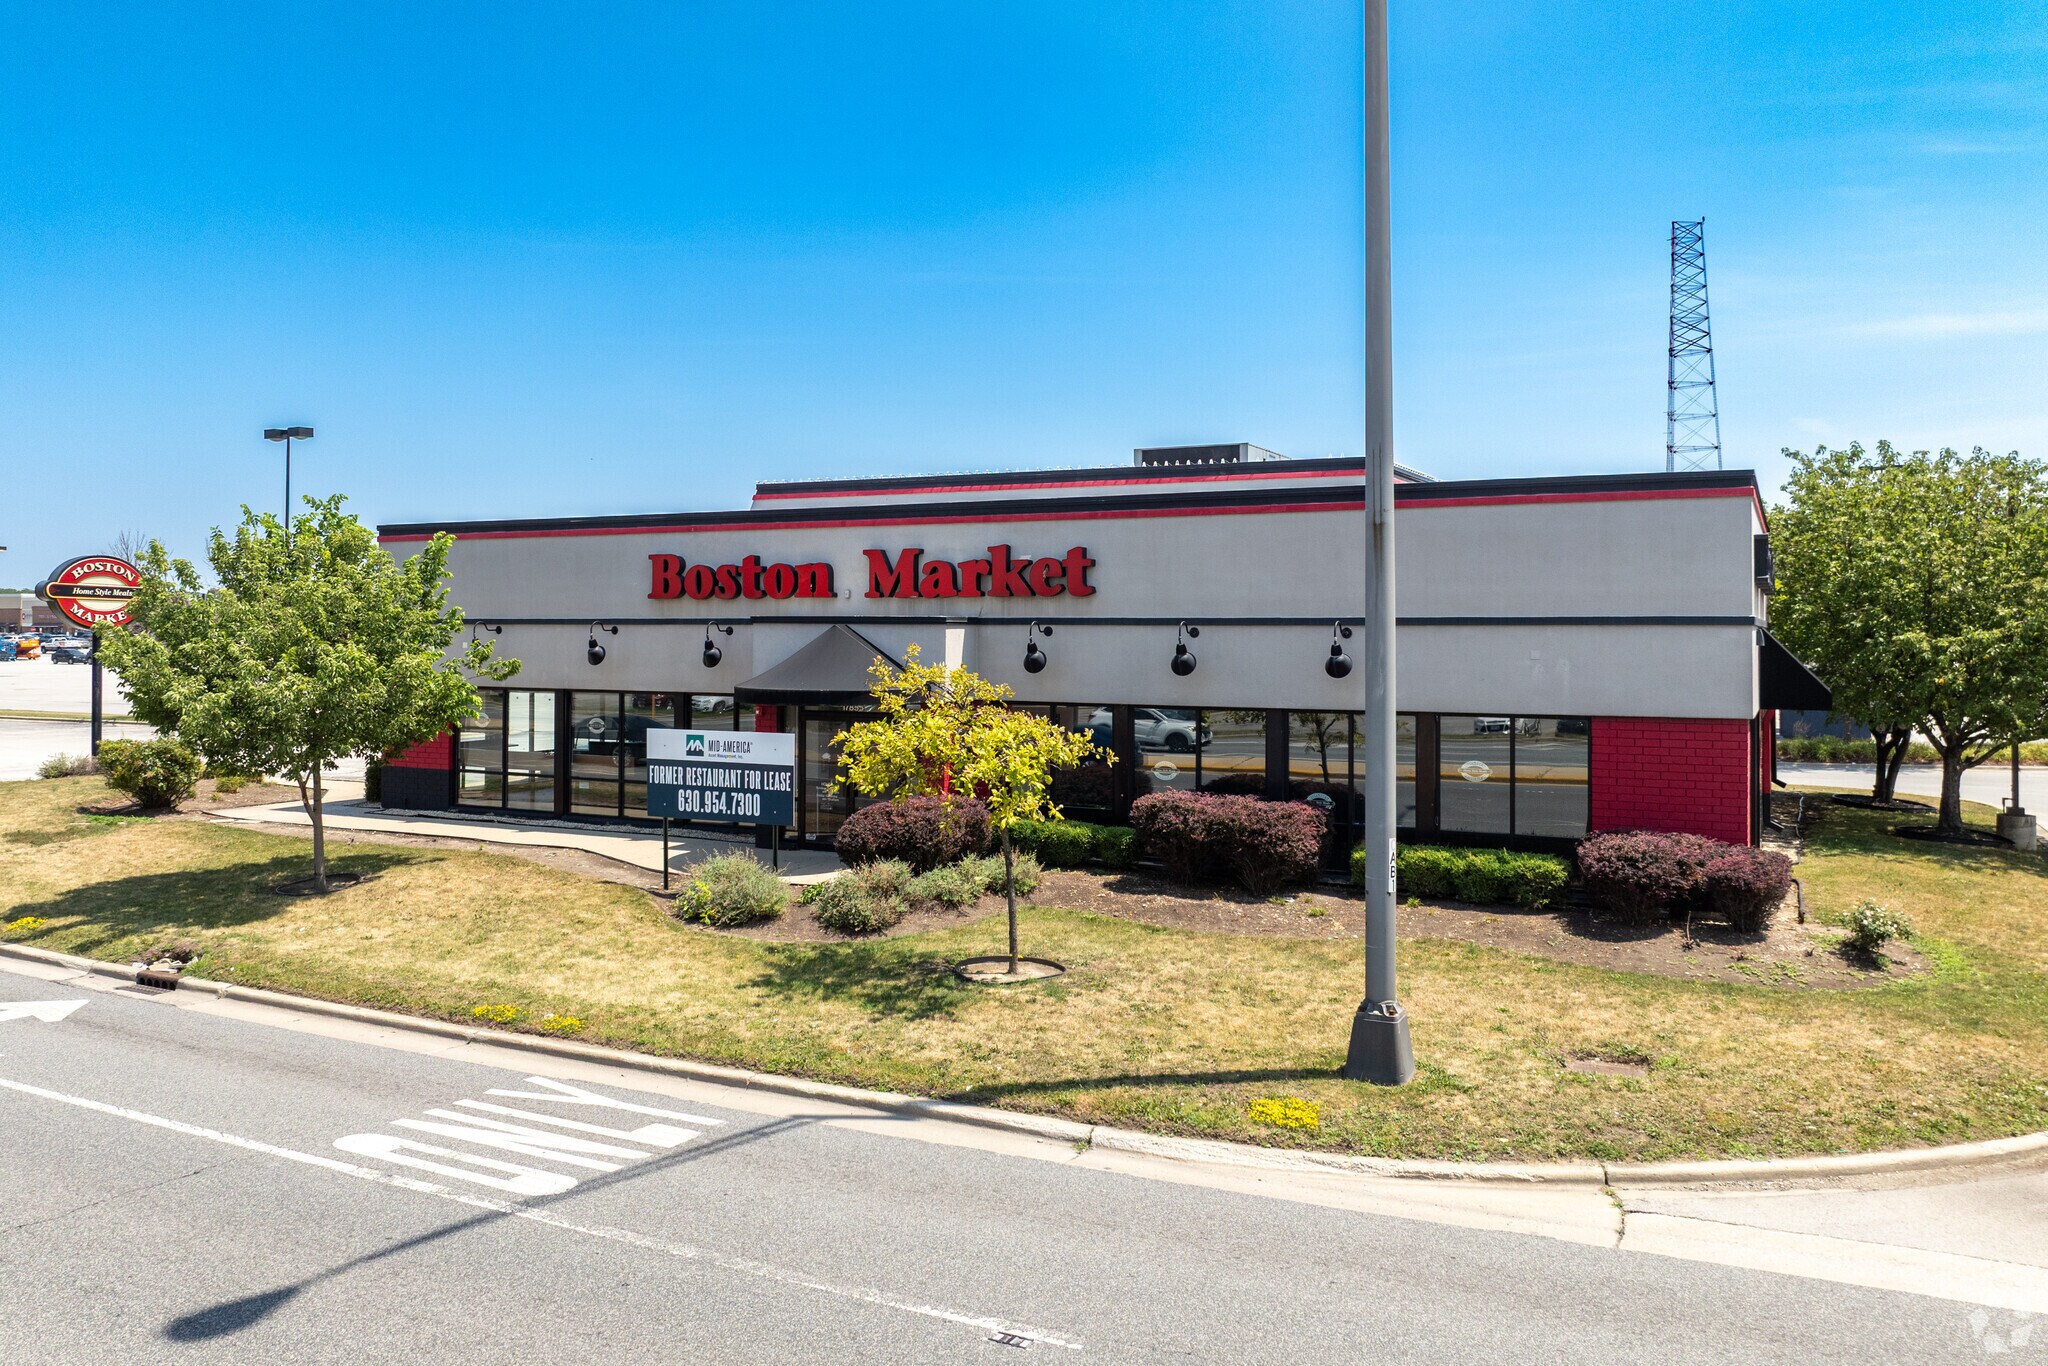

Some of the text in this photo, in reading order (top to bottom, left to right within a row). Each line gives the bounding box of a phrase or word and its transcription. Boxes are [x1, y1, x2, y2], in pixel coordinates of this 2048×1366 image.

[71, 562, 136, 582] BOSTON
[648, 544, 1096, 600] Boston Market
[72, 587, 133, 597] Home Style Meals
[70, 603, 127, 624] MARKE
[649, 765, 684, 785] FORMER
[686, 767, 742, 789] RESTAURANT
[744, 770, 761, 790] FOR
[764, 771, 792, 792] LEASE
[678, 789, 761, 817] 630.954.7300
[332, 1076, 726, 1196] ONLY
